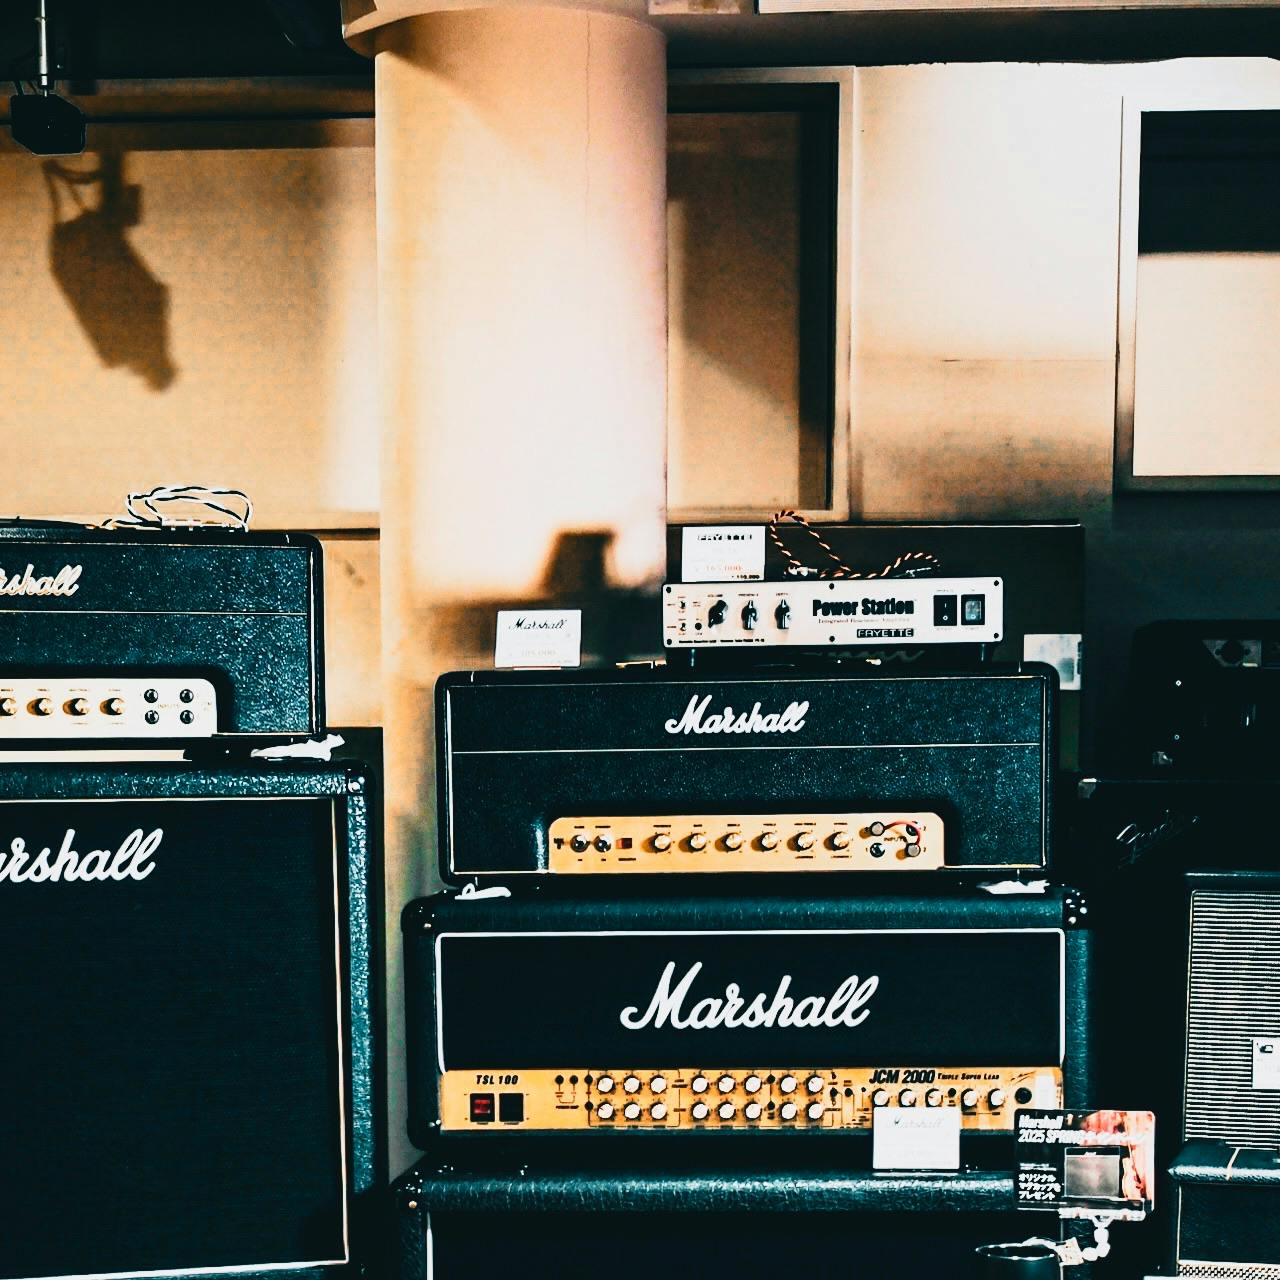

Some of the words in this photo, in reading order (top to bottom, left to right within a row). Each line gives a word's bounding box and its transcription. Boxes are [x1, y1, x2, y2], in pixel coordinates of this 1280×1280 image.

[812, 599, 859, 617] Power
[861, 597, 915, 616] Station
[857, 629, 913, 637] FAYETTE
[665, 695, 810, 735] Marshall
[620, 961, 880, 1030] Marshall
[476, 1074, 495, 1085] TSL
[498, 1074, 519, 1085] 100
[869, 1069, 900, 1084] JCM
[901, 1069, 936, 1084] 2000
[1017, 1129, 1046, 1143] 2025
